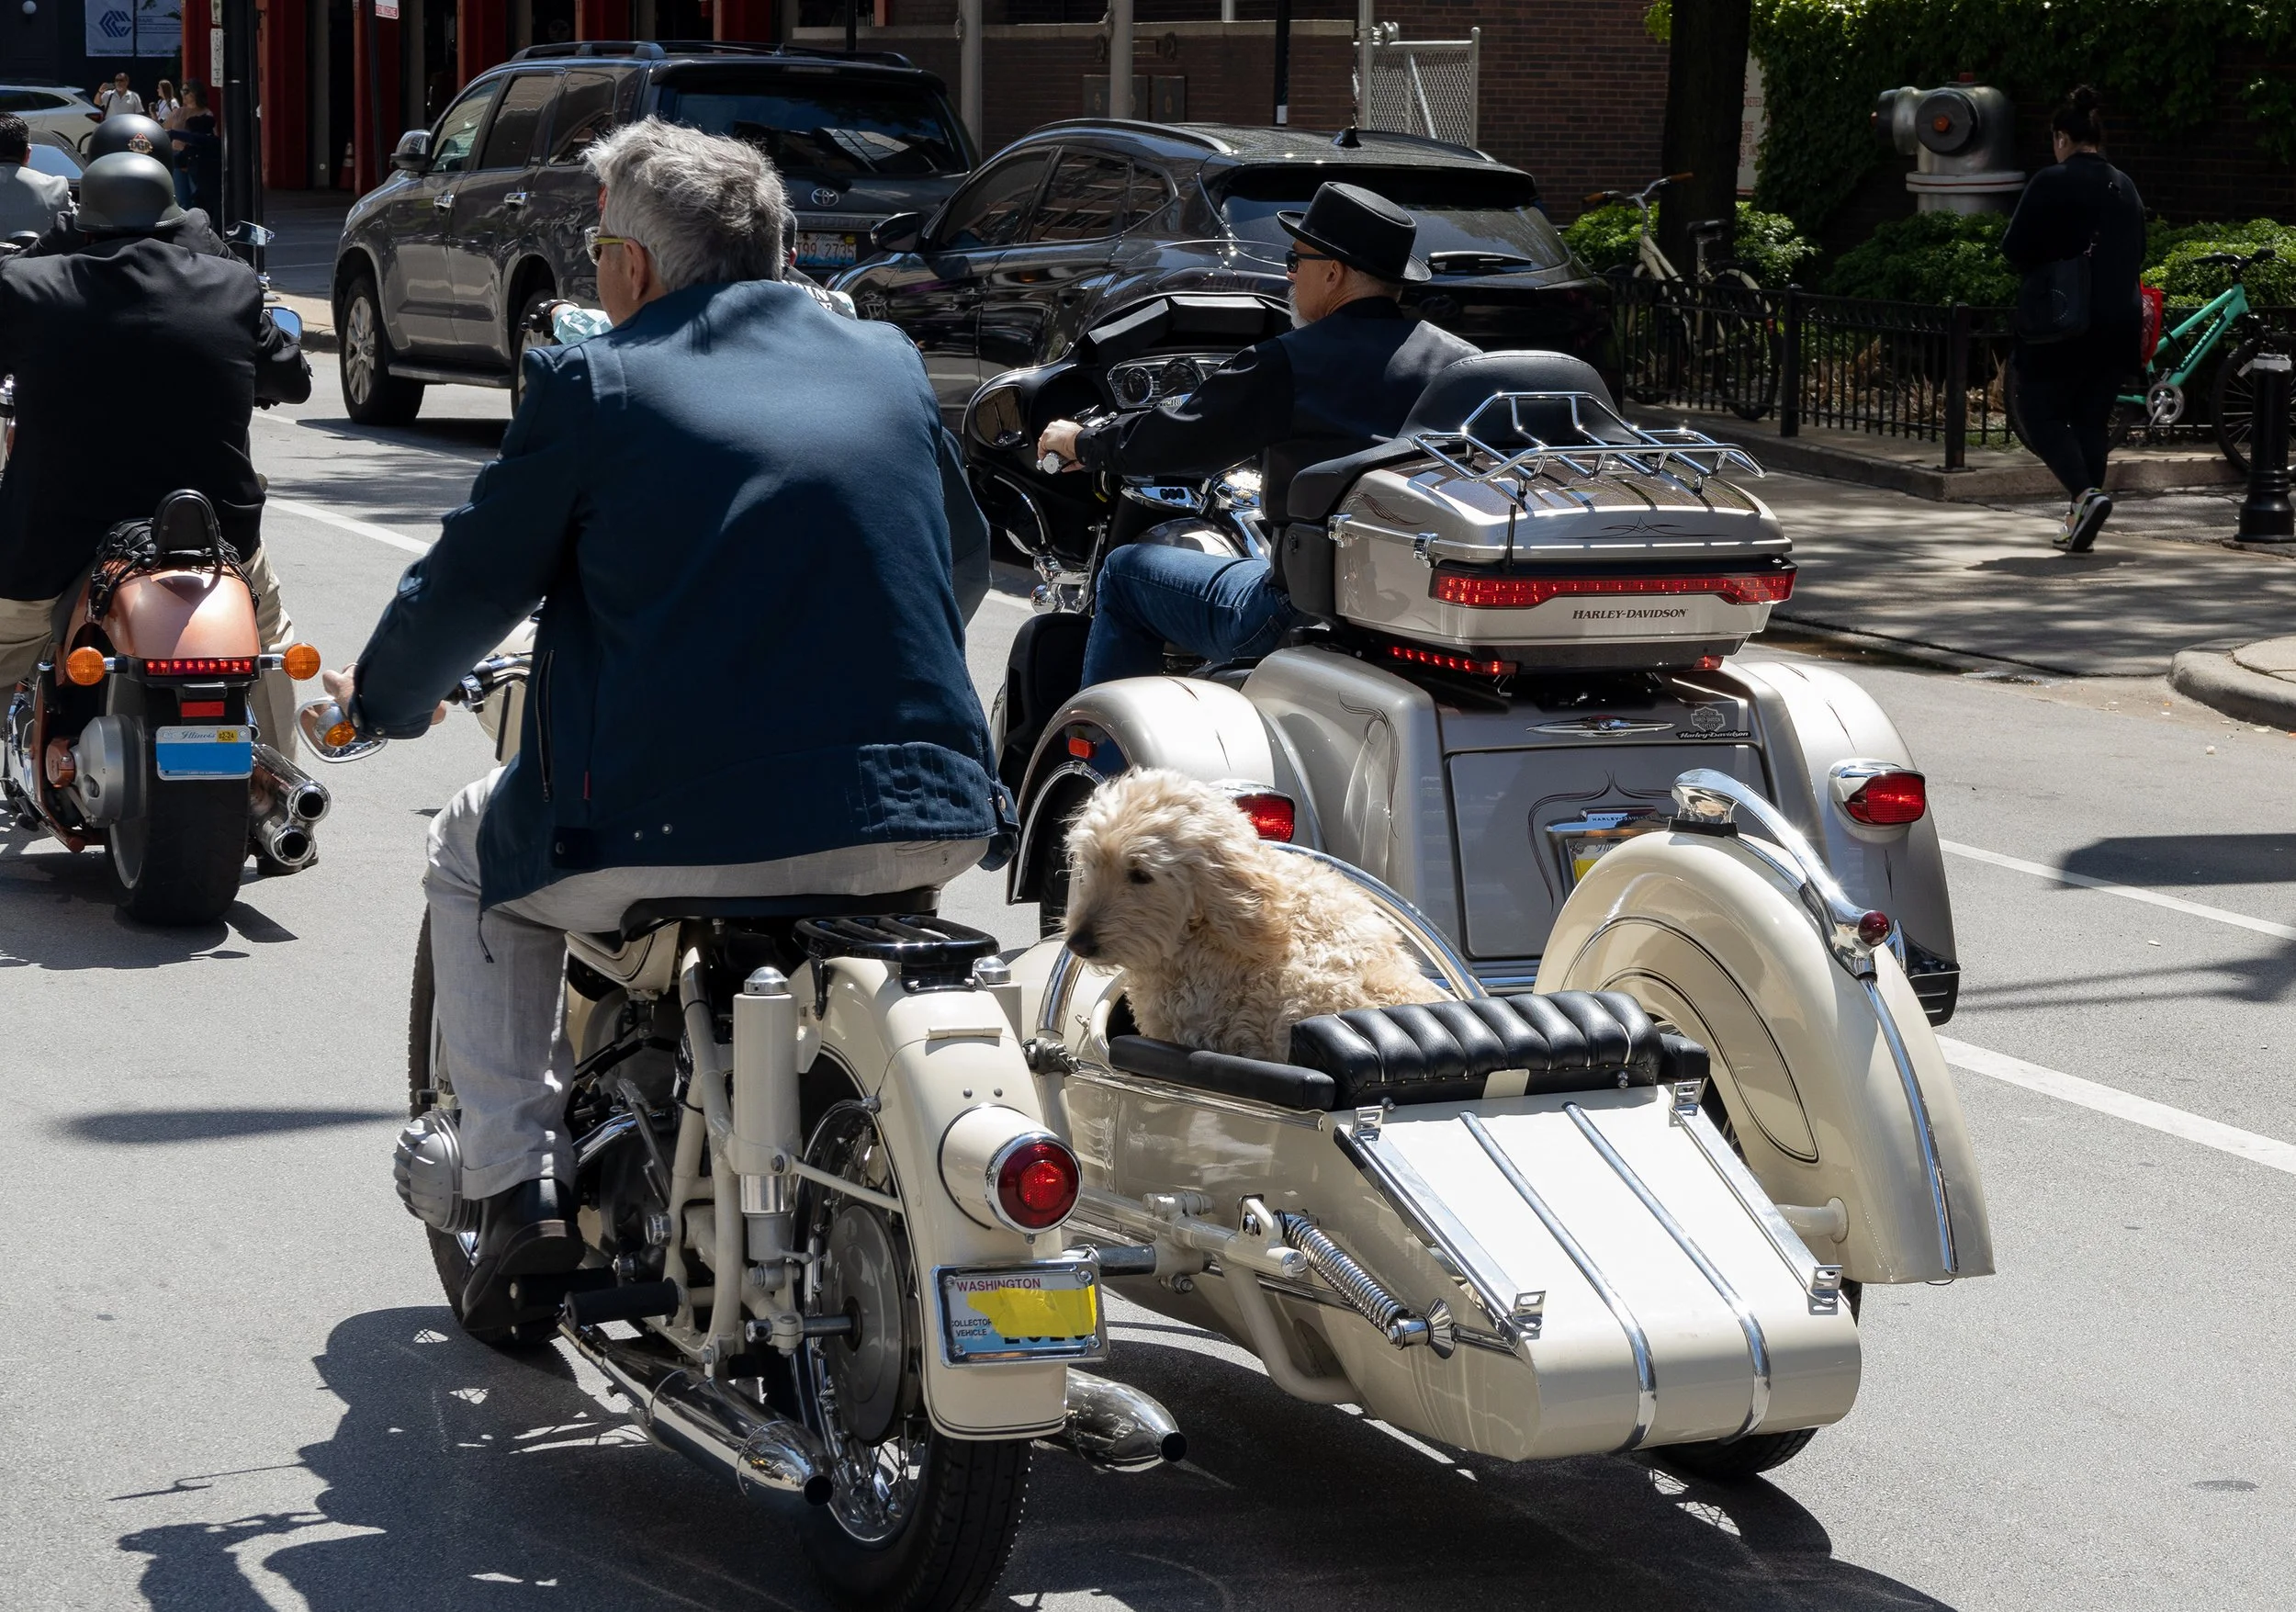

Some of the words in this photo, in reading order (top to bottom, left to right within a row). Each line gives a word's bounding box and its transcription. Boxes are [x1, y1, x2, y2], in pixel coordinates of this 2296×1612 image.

[1572, 609, 1686, 619] HARLEY-DAVIDSON
[181, 731, 216, 739] Illinois
[957, 1278, 1041, 1291] WASHINGTON
[956, 1328, 988, 1337] VEHICLE
